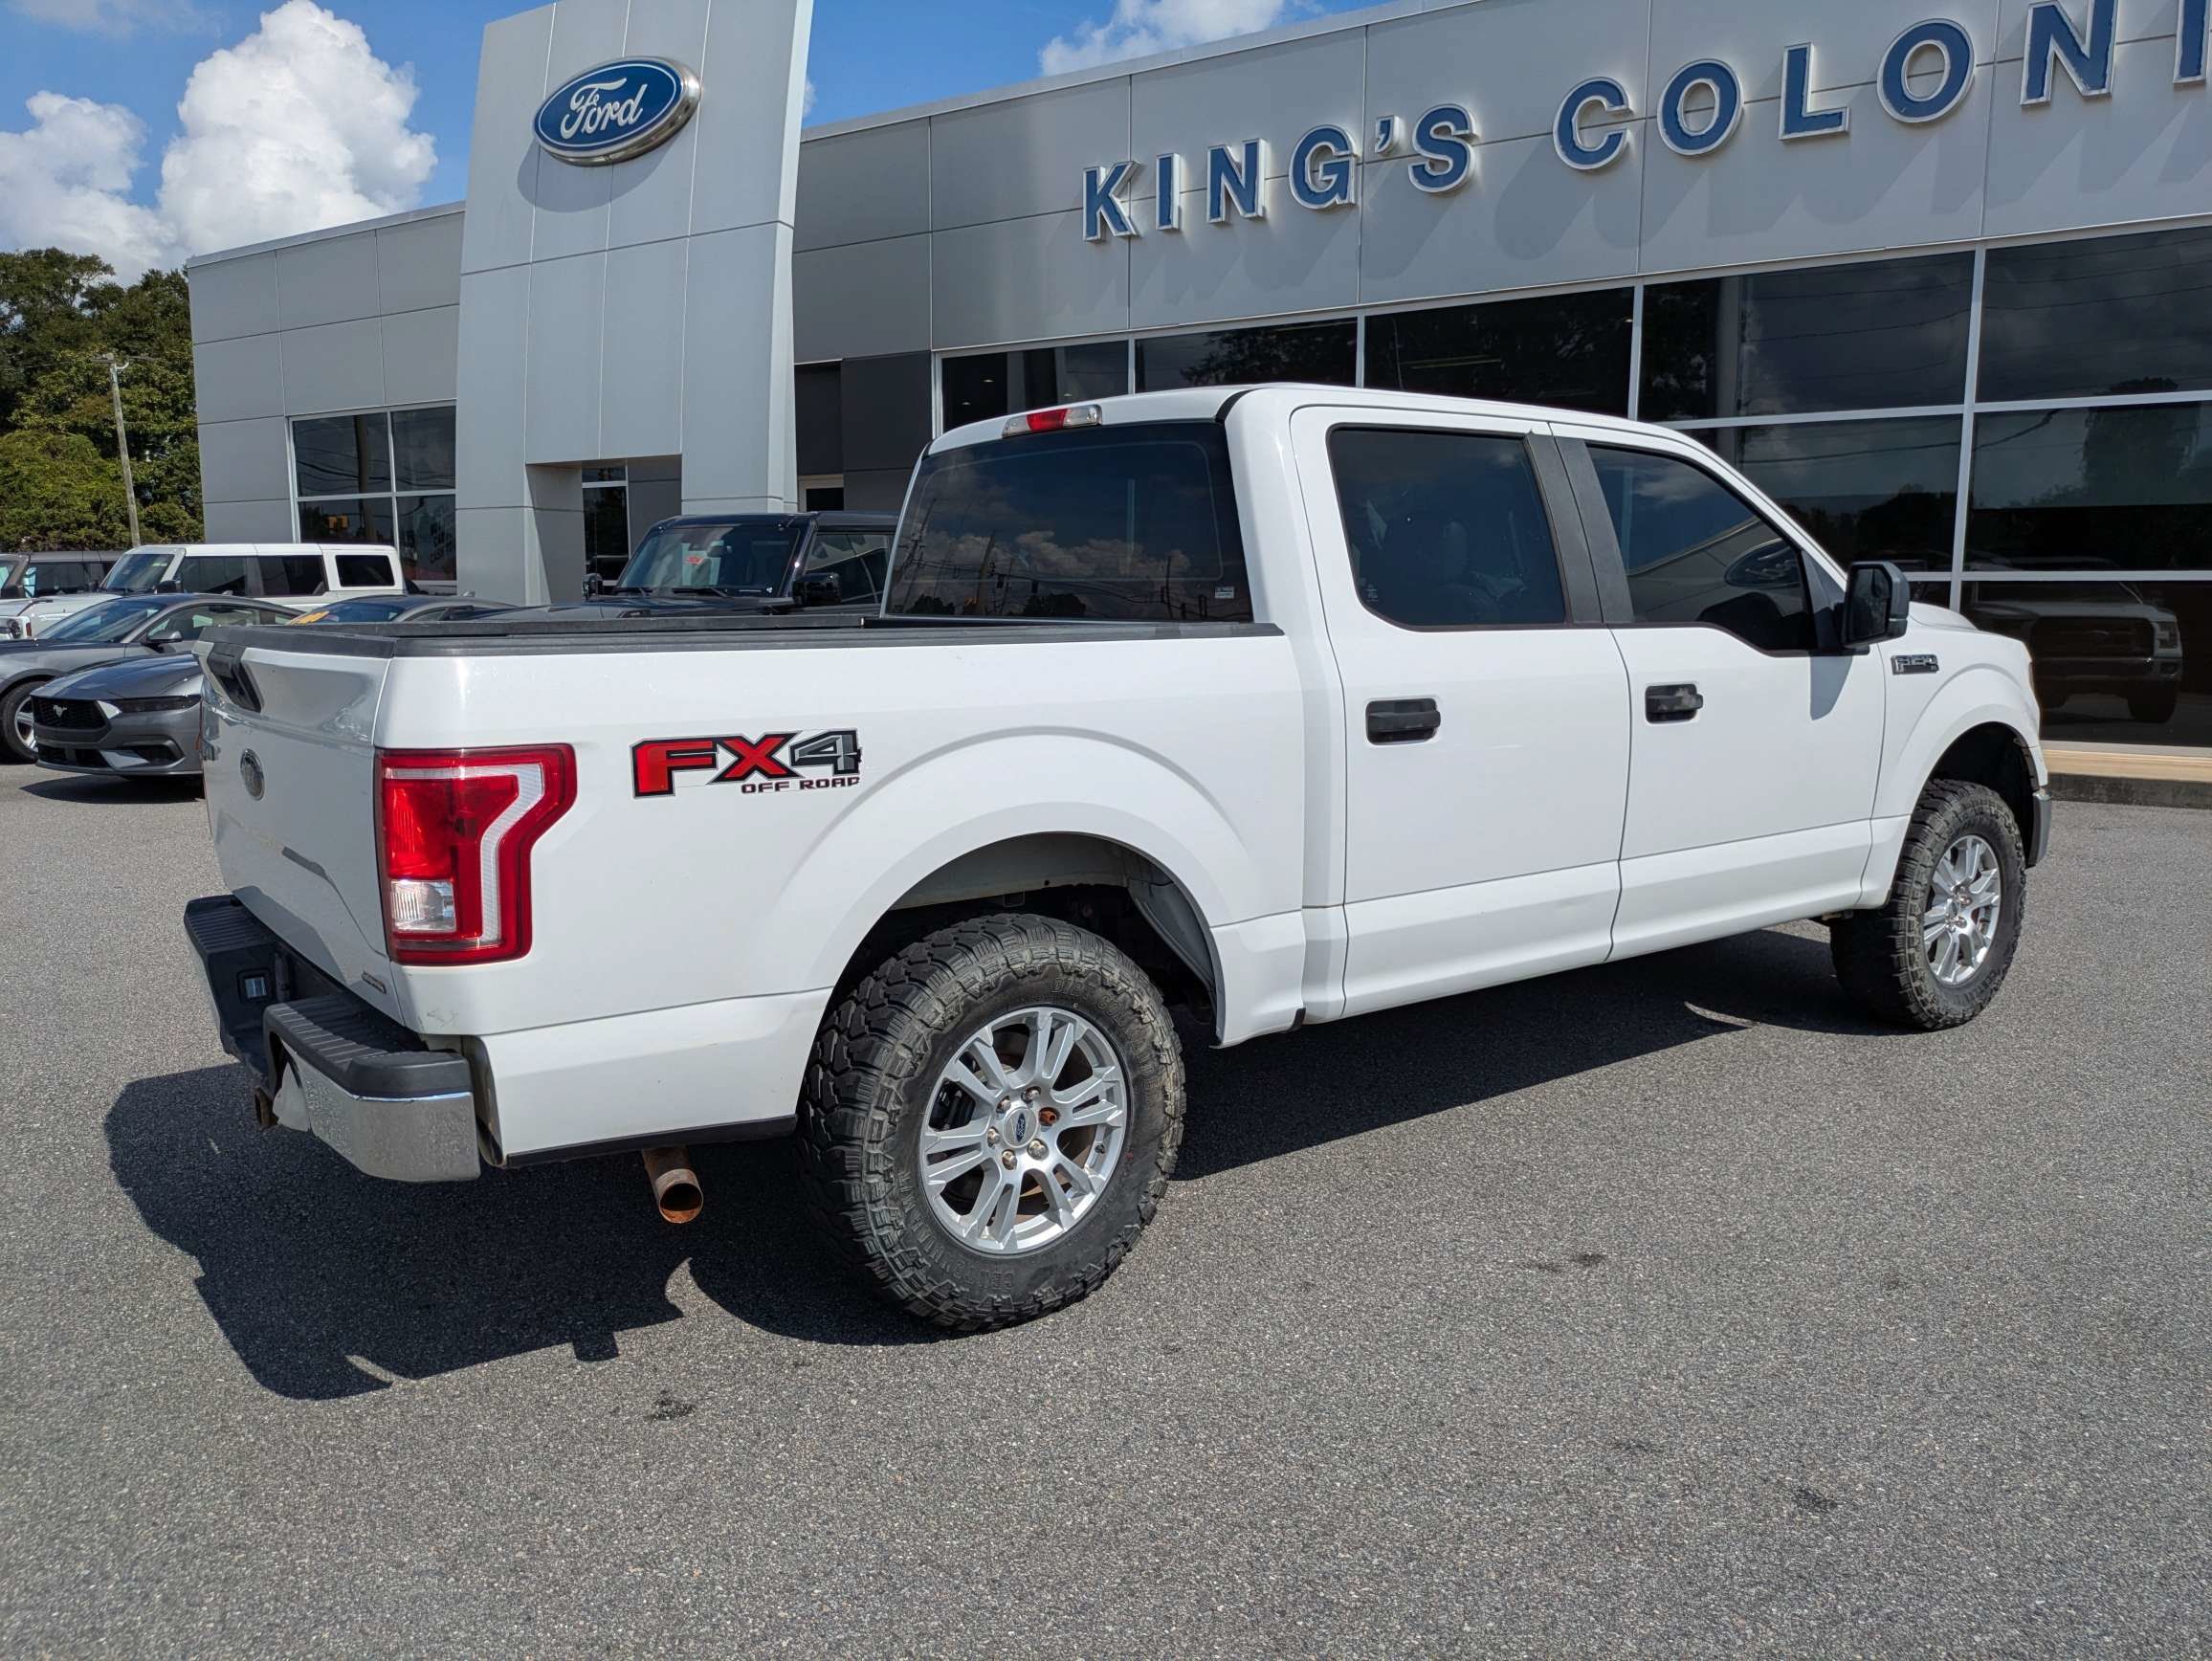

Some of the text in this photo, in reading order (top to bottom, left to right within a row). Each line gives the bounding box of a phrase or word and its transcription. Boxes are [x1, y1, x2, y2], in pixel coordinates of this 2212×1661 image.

[560, 78, 648, 140] Ford
[1553, 0, 2210, 171] COLONI
[630, 728, 862, 799] FX4
[741, 776, 861, 794] OFF ROAD
